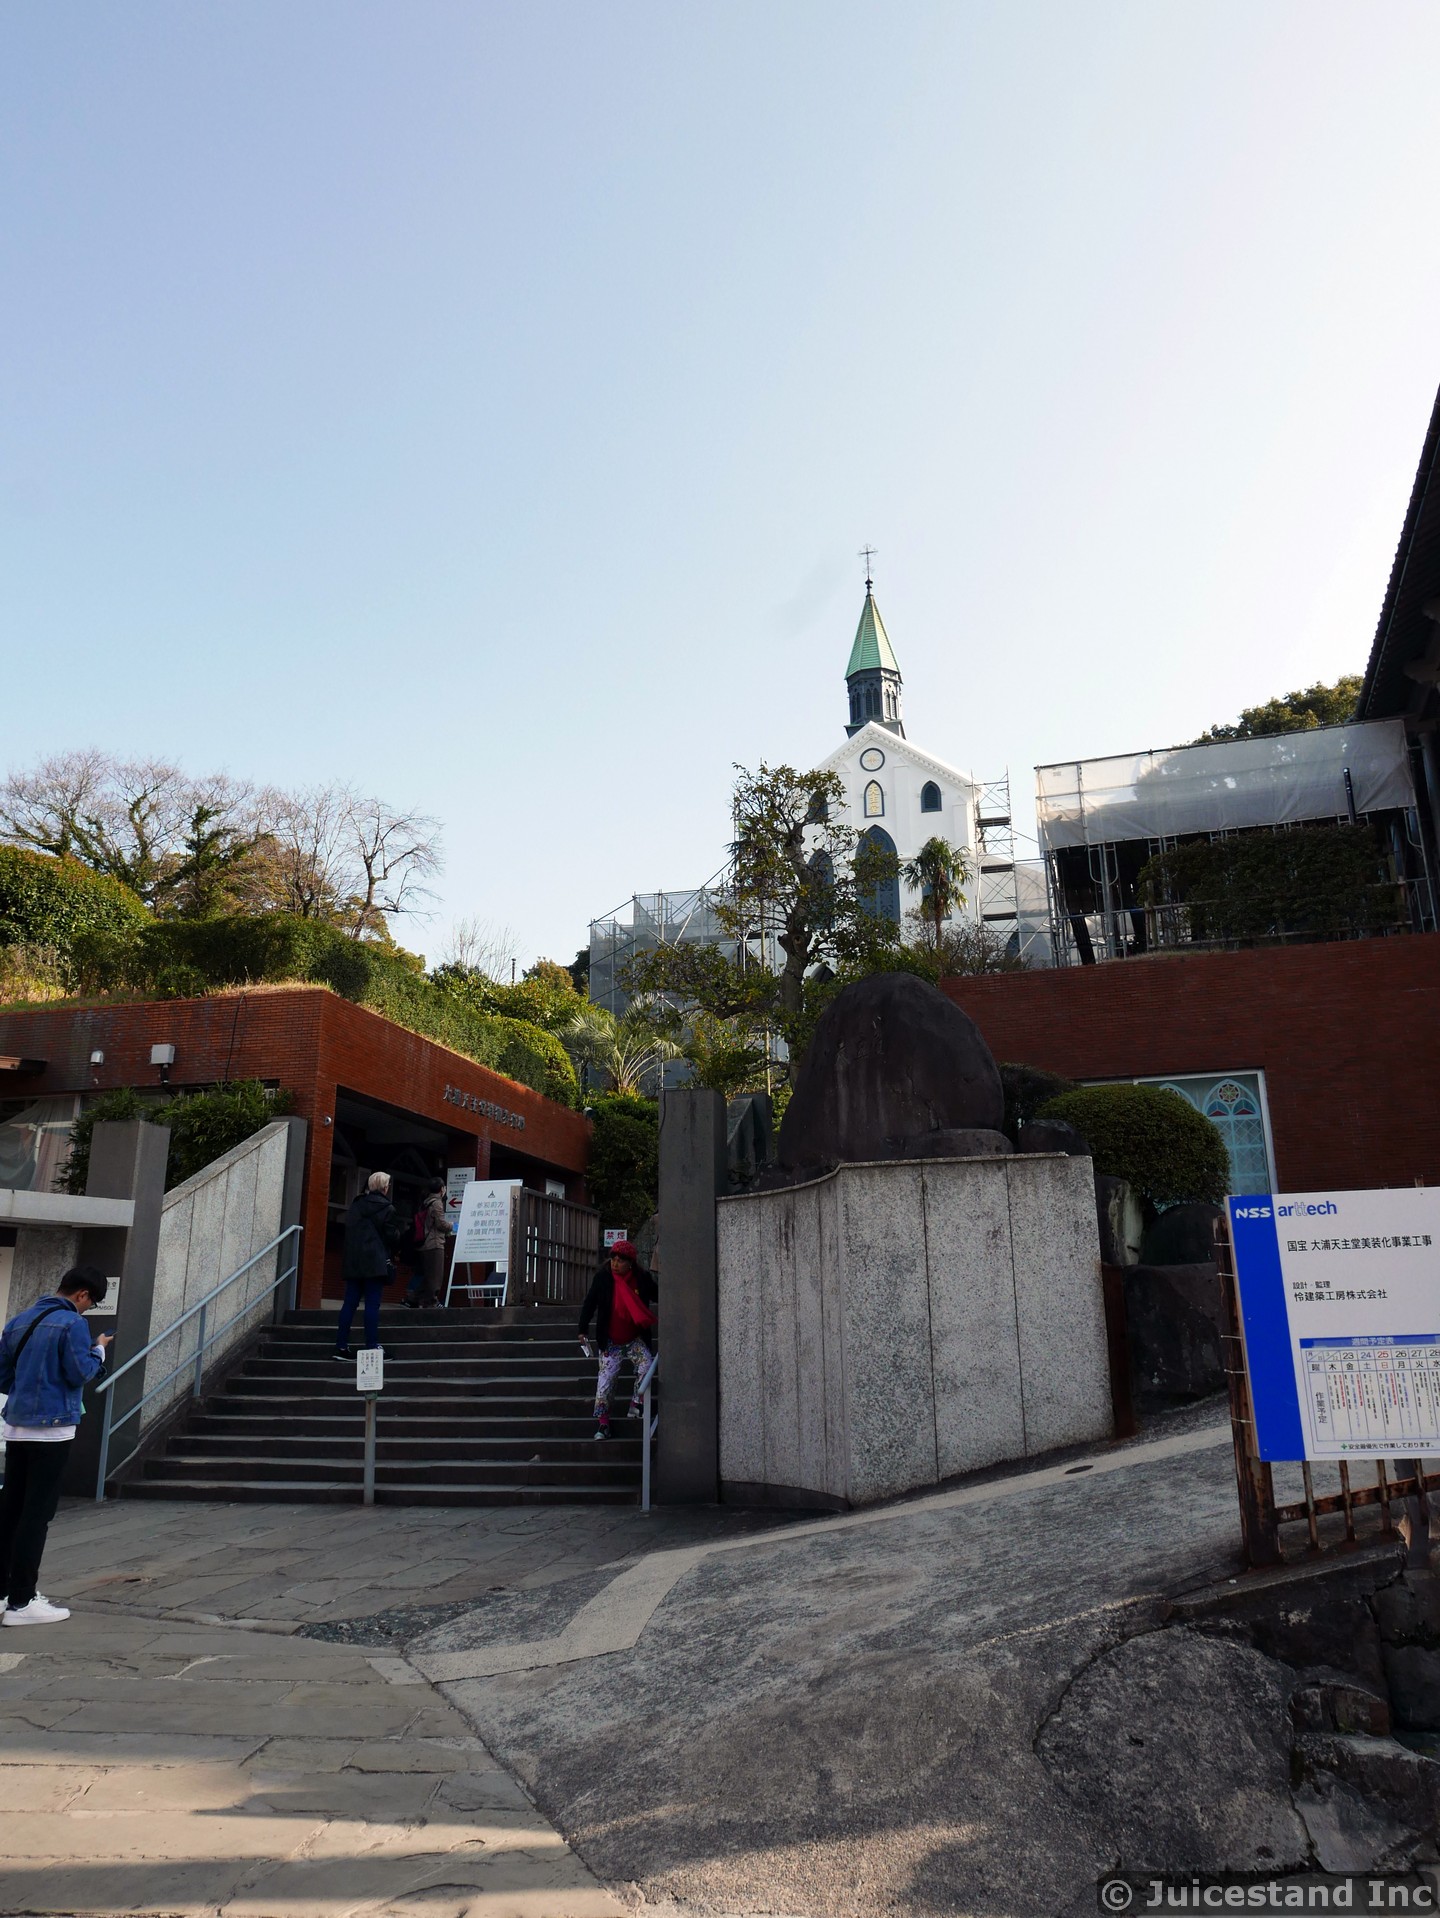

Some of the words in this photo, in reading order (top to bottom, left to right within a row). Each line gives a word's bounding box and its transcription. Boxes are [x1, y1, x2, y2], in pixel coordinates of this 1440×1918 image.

[1236, 1207, 1271, 1219] NSS
[1278, 1200, 1338, 1217] arttech
[1287, 1240, 1308, 1251] 国宝
[1311, 1235, 1432, 1251] 大浦天主堂美装化事業工事
[1294, 1288, 1388, 1301] 怜建築工房株式会社
[1343, 1352, 1354, 1360] 23
[1361, 1351, 1371, 1359] 24
[1395, 1350, 1407, 1358] 26
[1411, 1349, 1422, 1357] 27
[1429, 1349, 1440, 1357] 28
[1328, 1363, 1337, 1371] 木
[1346, 1362, 1354, 1370] 金
[1381, 1361, 1388, 1369] 日
[1397, 1361, 1406, 1369] 月
[1416, 1360, 1424, 1368] 火
